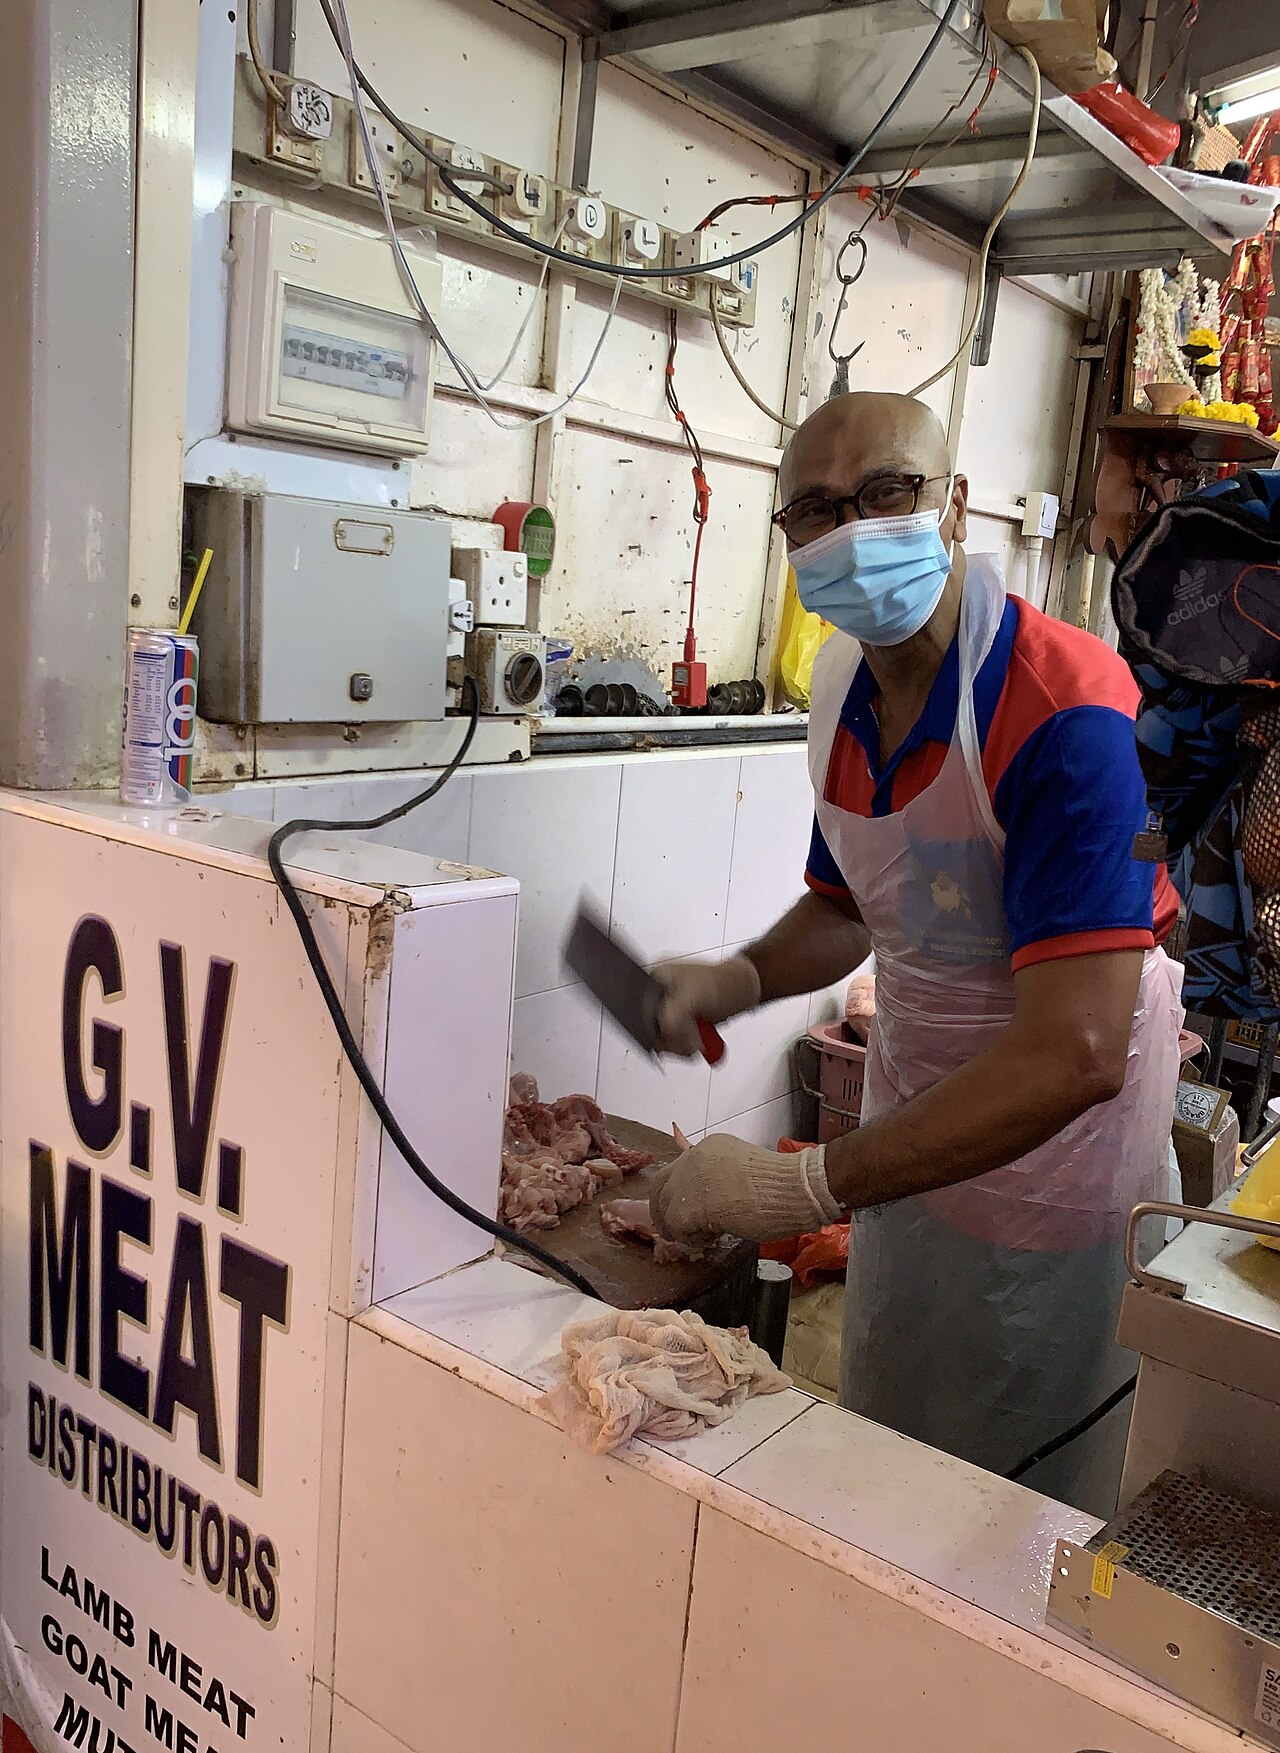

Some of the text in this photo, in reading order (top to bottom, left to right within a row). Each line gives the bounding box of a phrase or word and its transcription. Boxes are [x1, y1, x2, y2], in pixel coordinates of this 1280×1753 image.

[164, 678, 198, 762] 100
[62, 912, 245, 1221] G.V.
[28, 1138, 292, 1496] MEAT
[27, 1380, 280, 1632] DISTRIBUTORS
[41, 1545, 256, 1741] LAMB MEAT
[41, 1614, 219, 1753] GOAT ME
